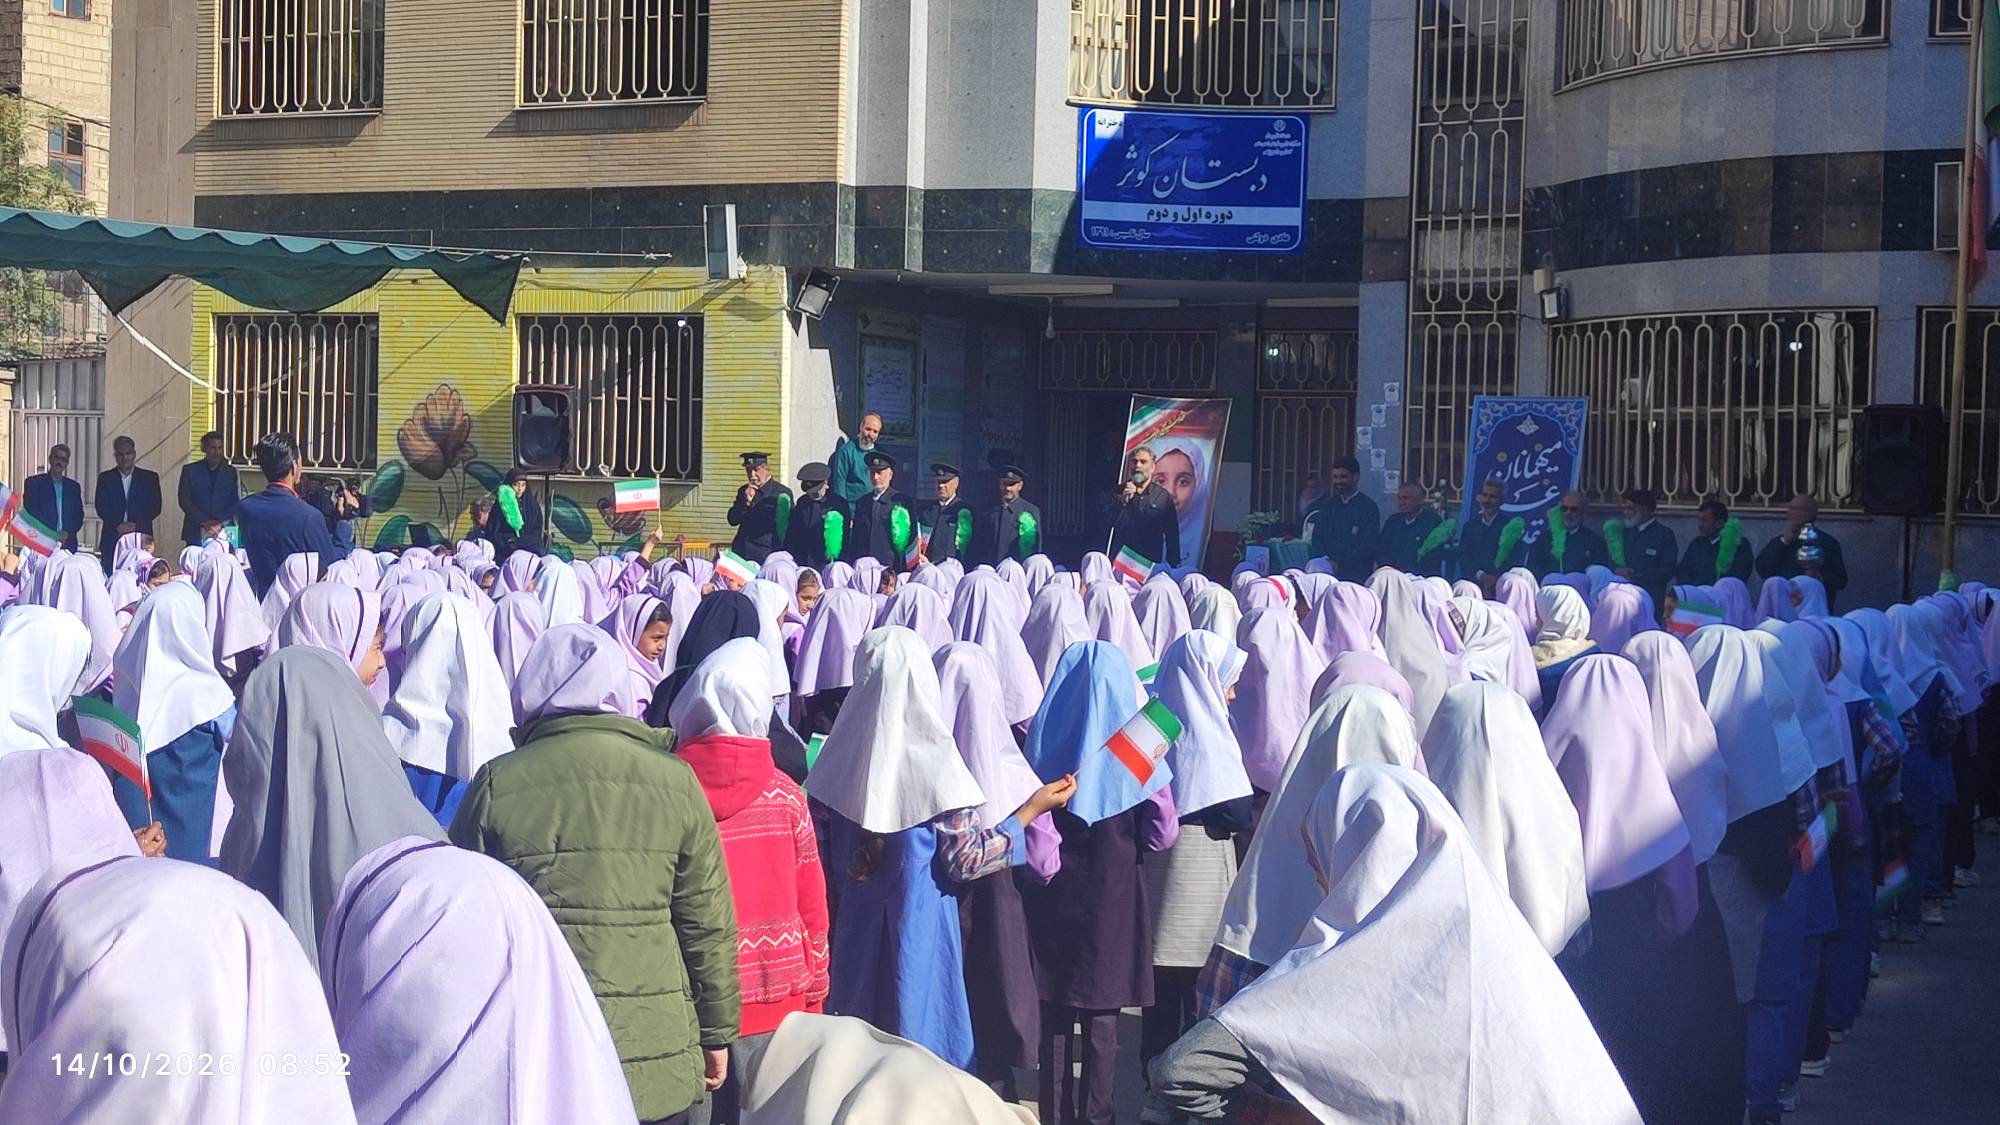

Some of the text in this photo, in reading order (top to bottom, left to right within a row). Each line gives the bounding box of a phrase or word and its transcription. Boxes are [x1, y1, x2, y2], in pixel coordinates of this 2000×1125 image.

[1116, 132, 1268, 199] دبستان کوثر
[1146, 206, 1234, 224] دوره اول و دوم
